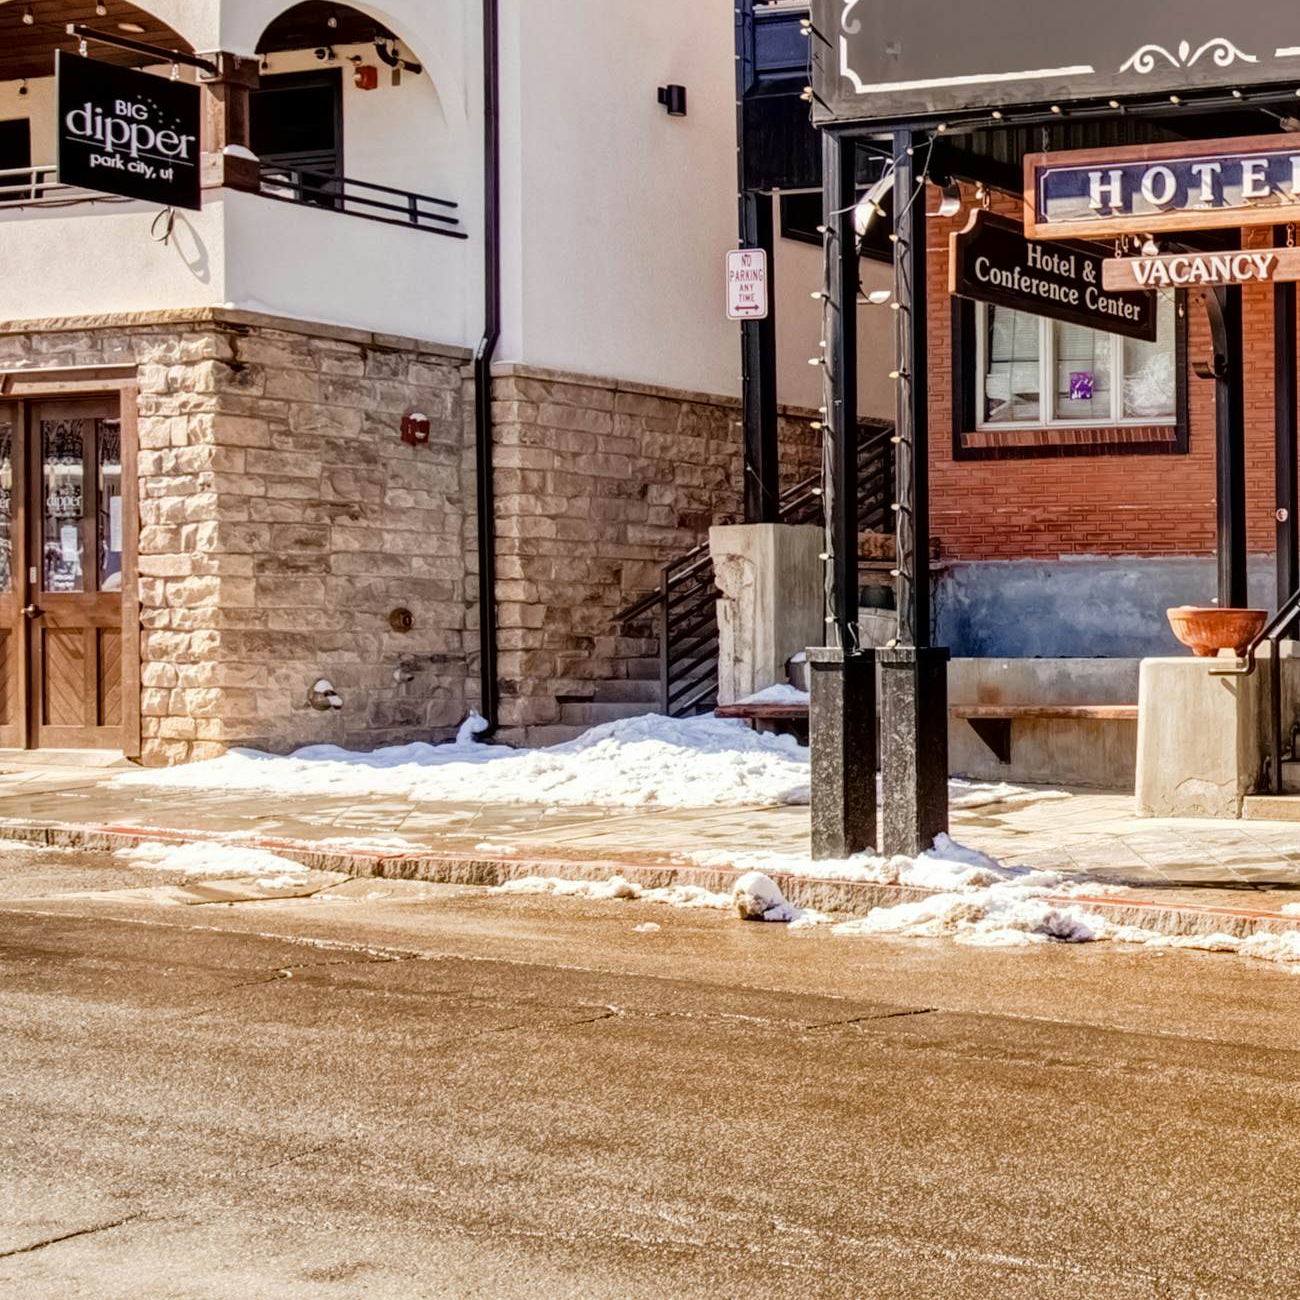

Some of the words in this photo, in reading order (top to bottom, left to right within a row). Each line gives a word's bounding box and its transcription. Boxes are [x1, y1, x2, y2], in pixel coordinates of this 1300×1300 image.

[115, 99, 149, 120] BIG
[65, 102, 196, 159] dipper
[90, 153, 125, 170] park
[127, 160, 157, 180] city,
[159, 167, 174, 181] ut
[741, 255, 752, 267] NO
[1026, 242, 1076, 279] Hotel
[1082, 259, 1097, 284] &
[1130, 252, 1275, 286] VACANCY
[729, 269, 764, 282] PARKING
[739, 283, 754, 292] ANY
[738, 293, 755, 302] TIME
[975, 256, 1080, 305] Conference
[1085, 286, 1142, 321] Center
